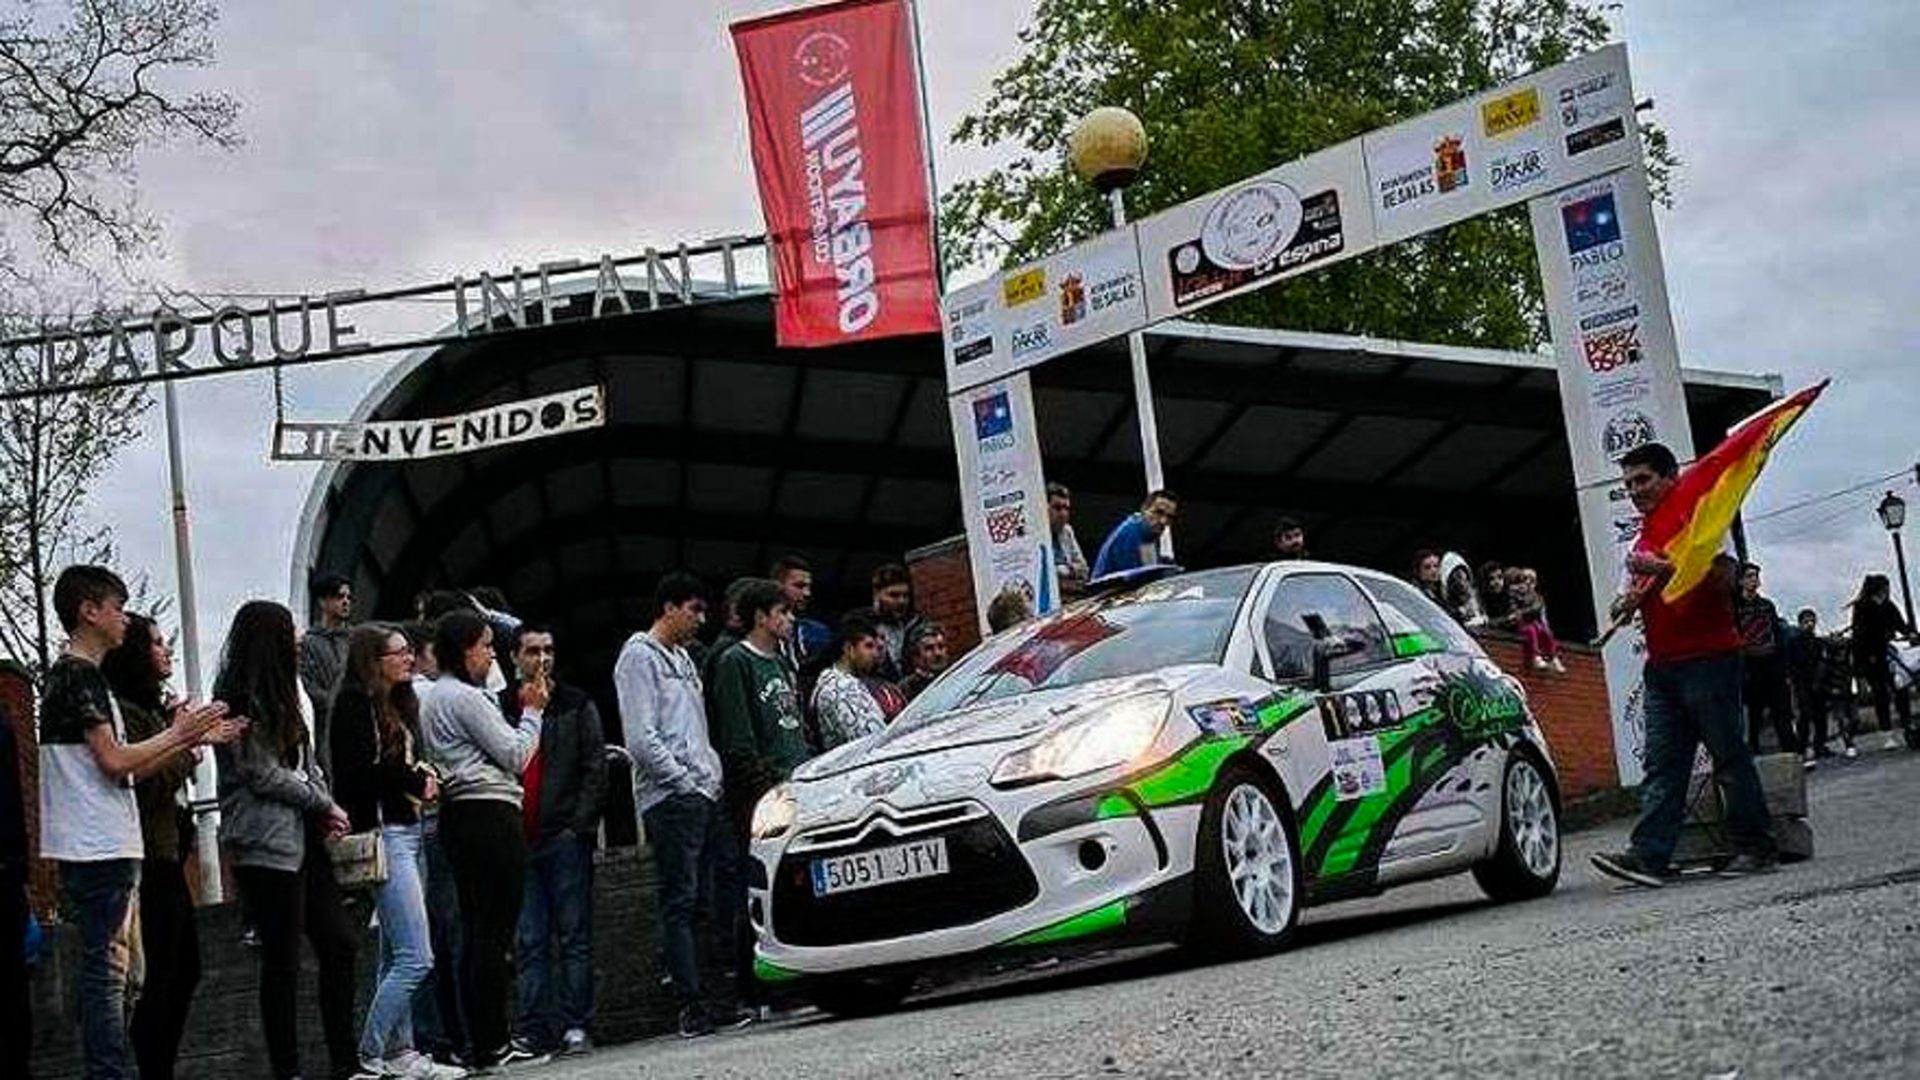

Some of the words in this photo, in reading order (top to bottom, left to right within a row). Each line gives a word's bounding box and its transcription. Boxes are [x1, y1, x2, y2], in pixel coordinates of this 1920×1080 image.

[1491, 151, 1541, 187] DAKAR
[48, 290, 371, 388] PARQUE
[282, 393, 600, 456] BIENVENIDOS
[829, 858, 885, 888] 5051
[899, 842, 940, 874] JTV
